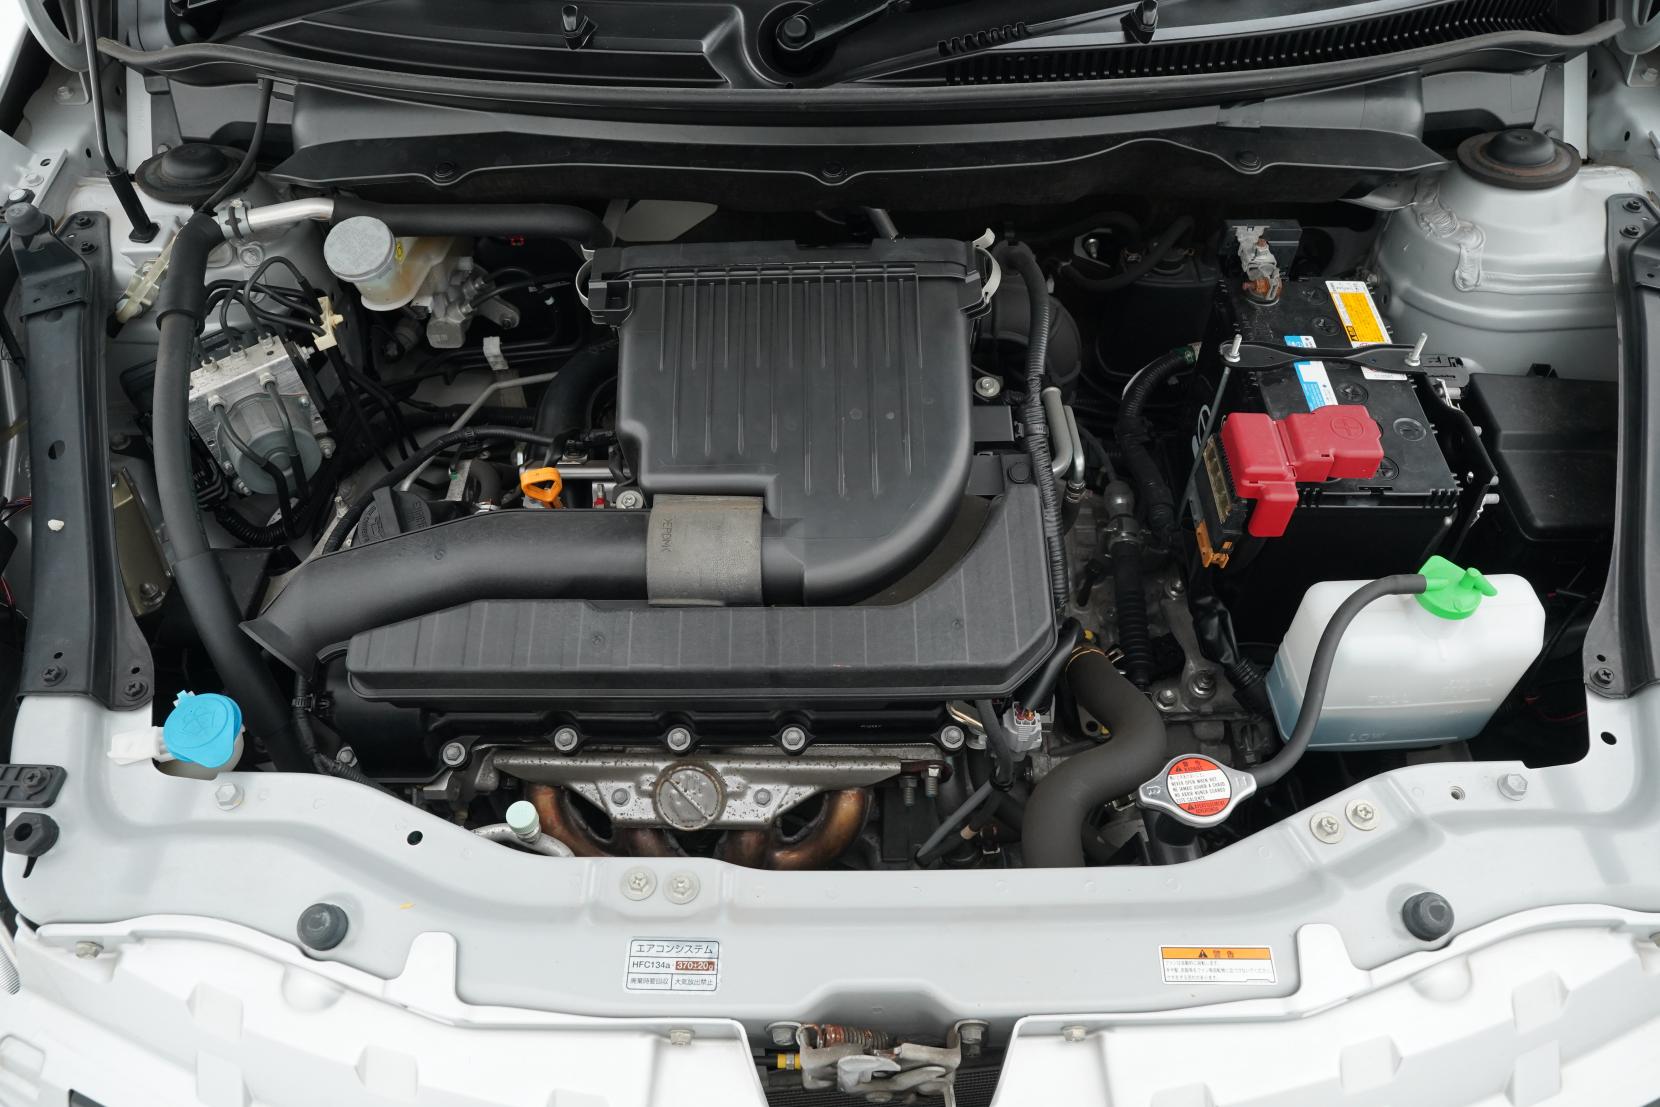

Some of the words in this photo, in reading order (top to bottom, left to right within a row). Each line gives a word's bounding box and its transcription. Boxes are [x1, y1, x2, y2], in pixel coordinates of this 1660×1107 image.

[636, 944, 713, 954] エアコンシステム
[632, 961, 671, 969] HFC134a
